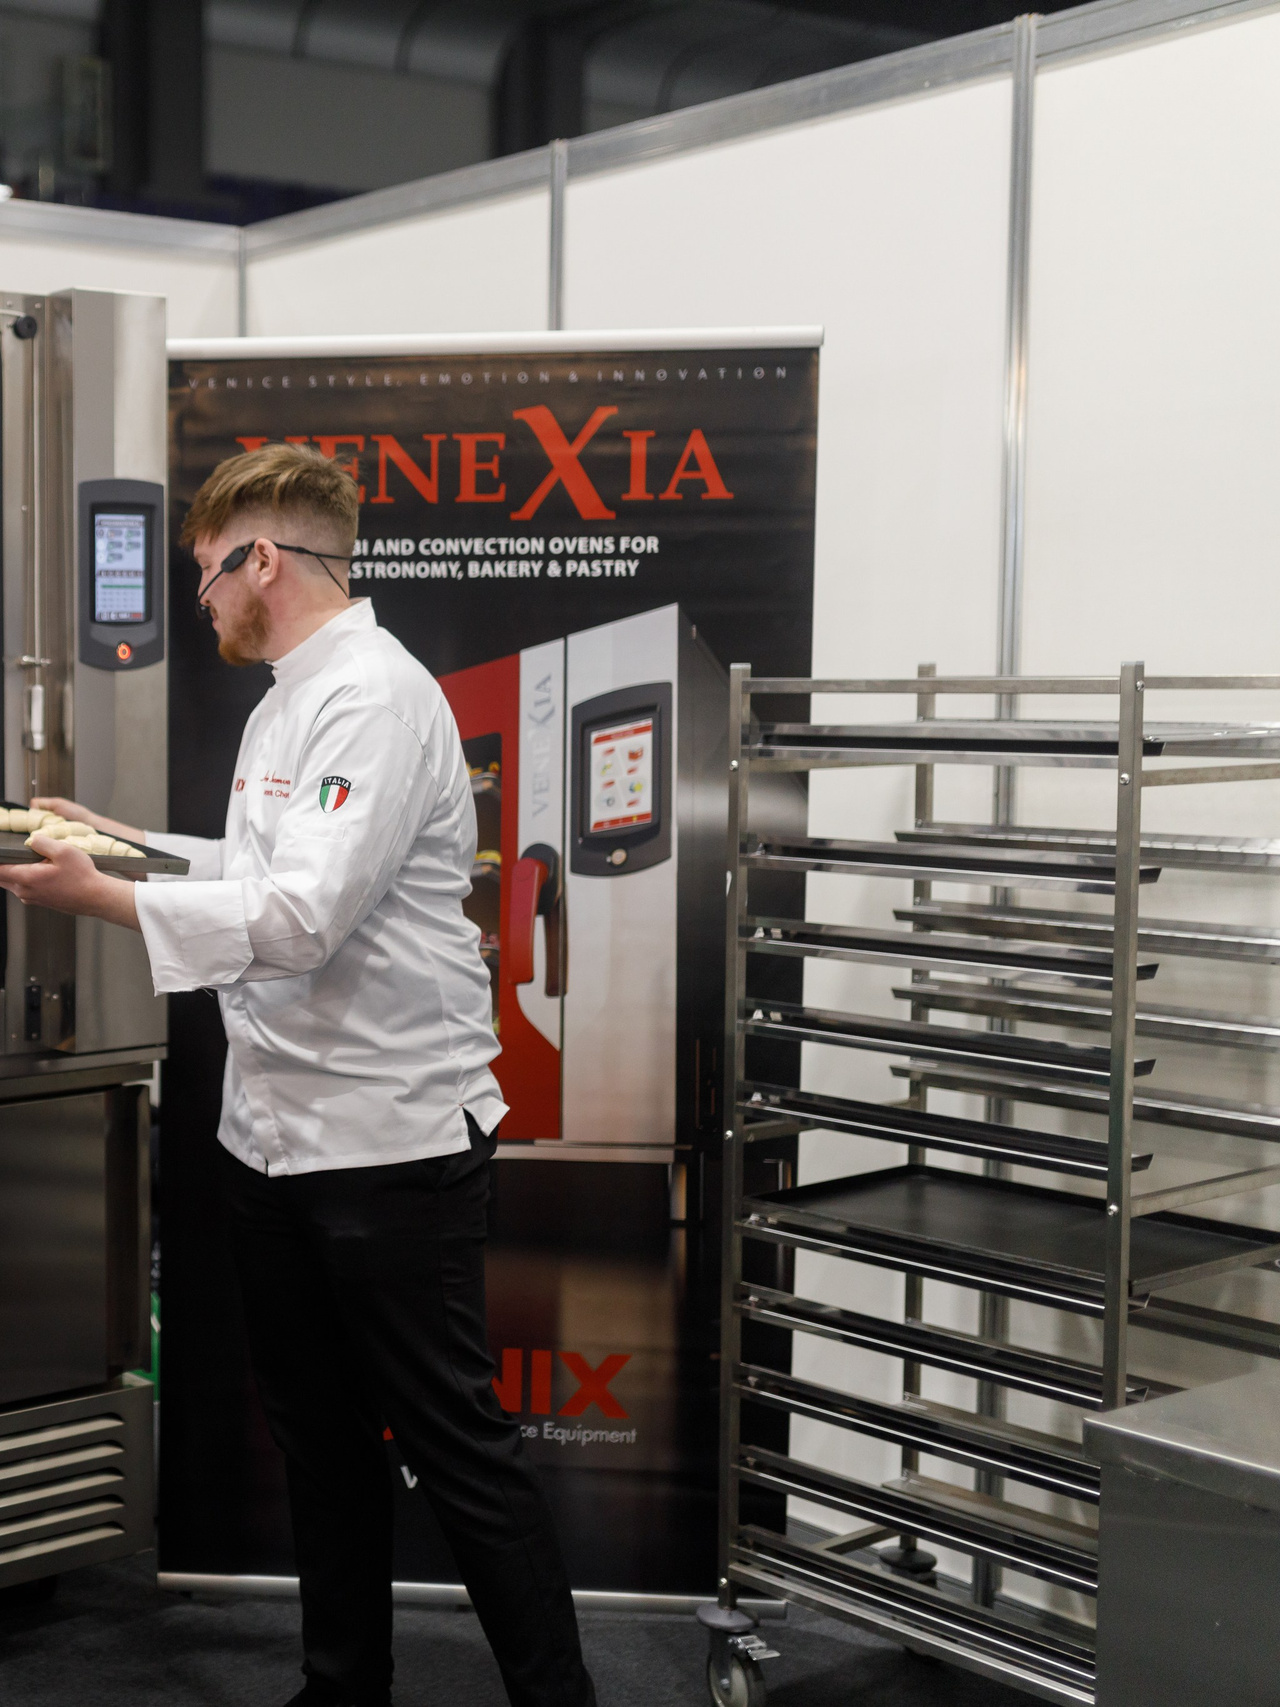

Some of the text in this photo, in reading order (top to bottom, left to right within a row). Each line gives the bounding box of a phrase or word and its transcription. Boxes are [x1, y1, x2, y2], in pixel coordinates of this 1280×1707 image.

[188, 376, 290, 389] VENICE
[420, 371, 550, 386] EMOTION
[569, 371, 578, 383] &
[598, 366, 787, 382] INNOVATION
[235, 403, 735, 521] ENEXIA
[372, 538, 416, 556] AND
[418, 537, 545, 556] CONVECTION
[548, 536, 616, 555] OVENS
[620, 535, 660, 554] FOR
[348, 558, 640, 580] STRONOMY, BAKERY & PASTRY
[323, 777, 350, 789] ITALIA
[543, 1421, 638, 1446] Equipment
